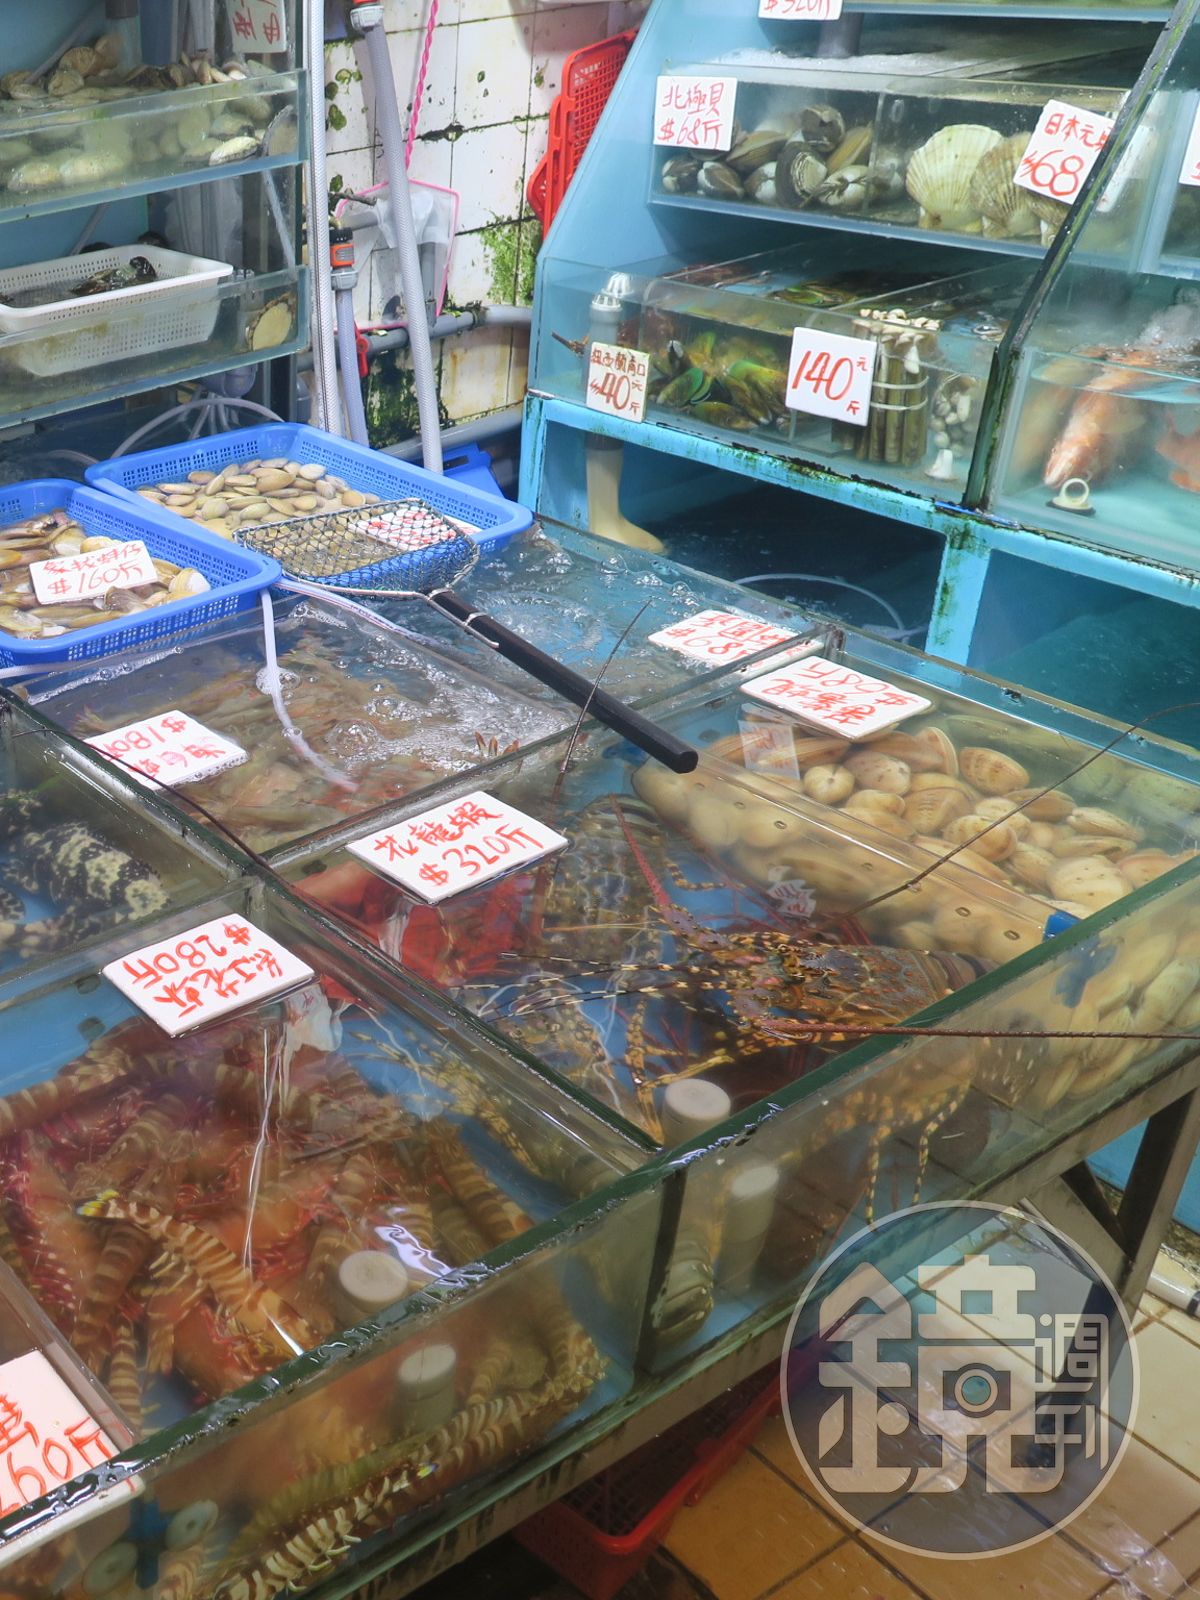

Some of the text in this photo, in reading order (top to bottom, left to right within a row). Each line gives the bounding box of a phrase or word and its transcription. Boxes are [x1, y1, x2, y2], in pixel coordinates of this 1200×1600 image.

[662, 82, 725, 116] 北極貝
[419, 823, 544, 887] $320斤
